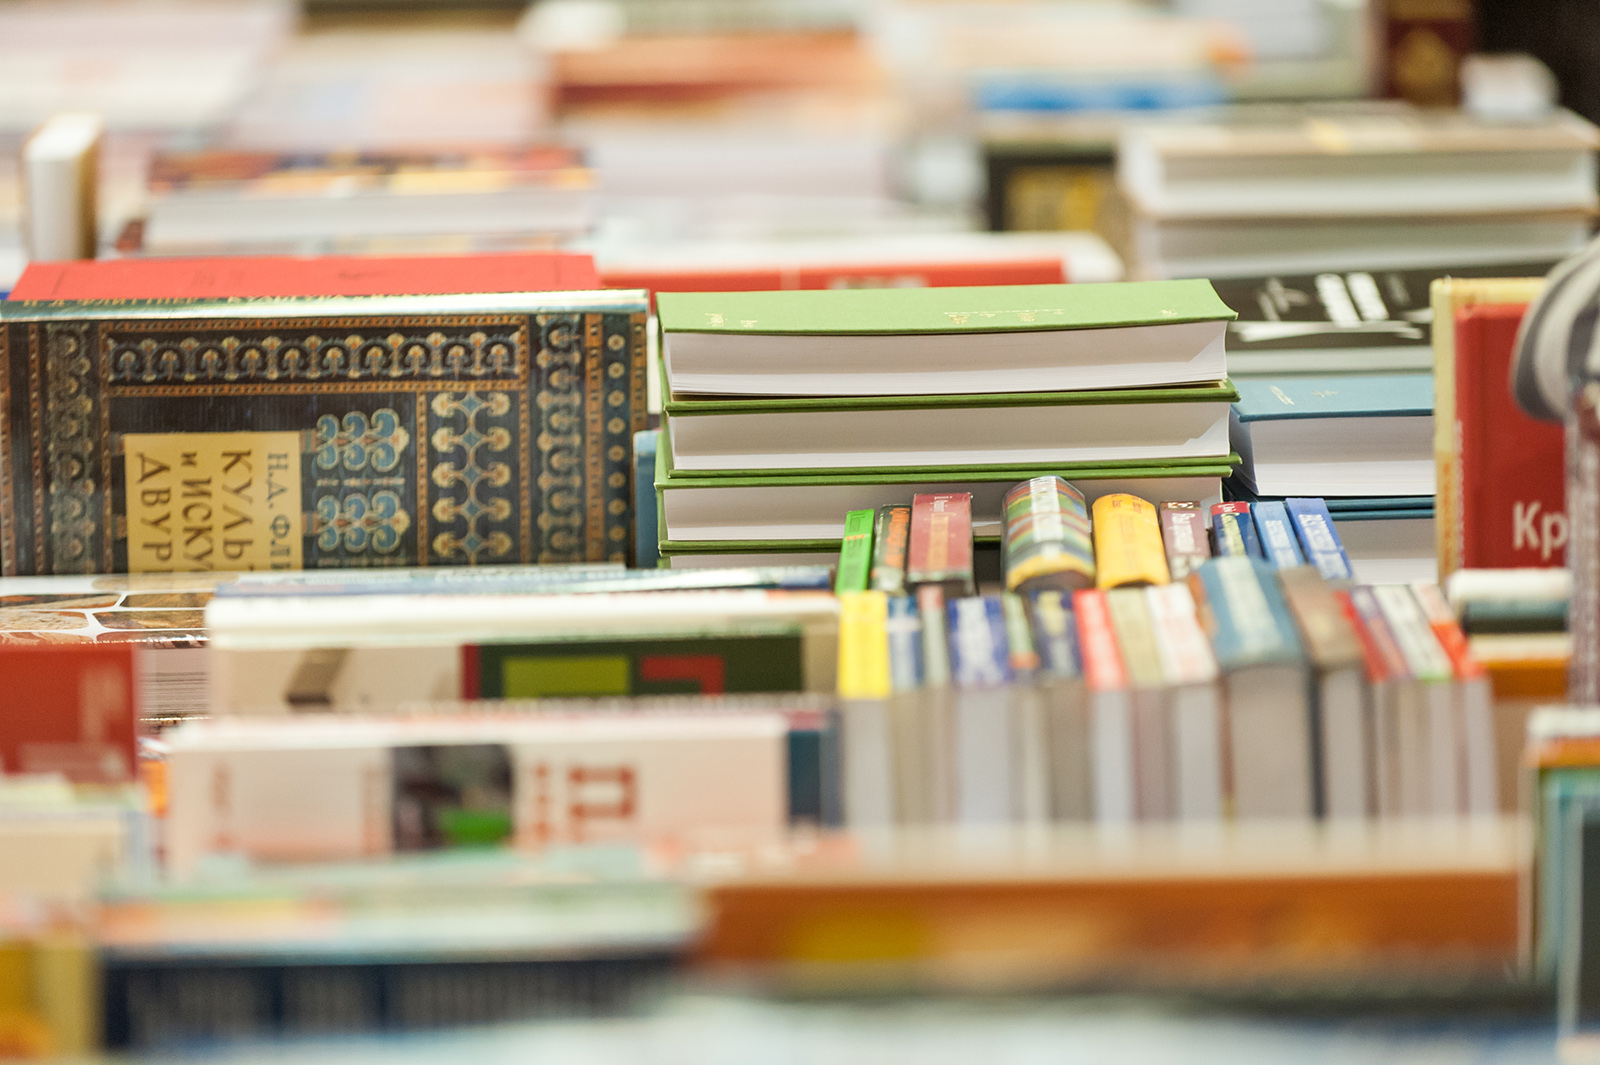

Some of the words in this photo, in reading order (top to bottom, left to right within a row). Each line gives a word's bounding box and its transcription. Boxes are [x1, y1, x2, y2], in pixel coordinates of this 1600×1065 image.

[137, 452, 172, 573] ДВУР
[181, 476, 213, 572] ИСКУ
[221, 449, 254, 572] КУЛЬ
[270, 515, 291, 570] ФЛ
